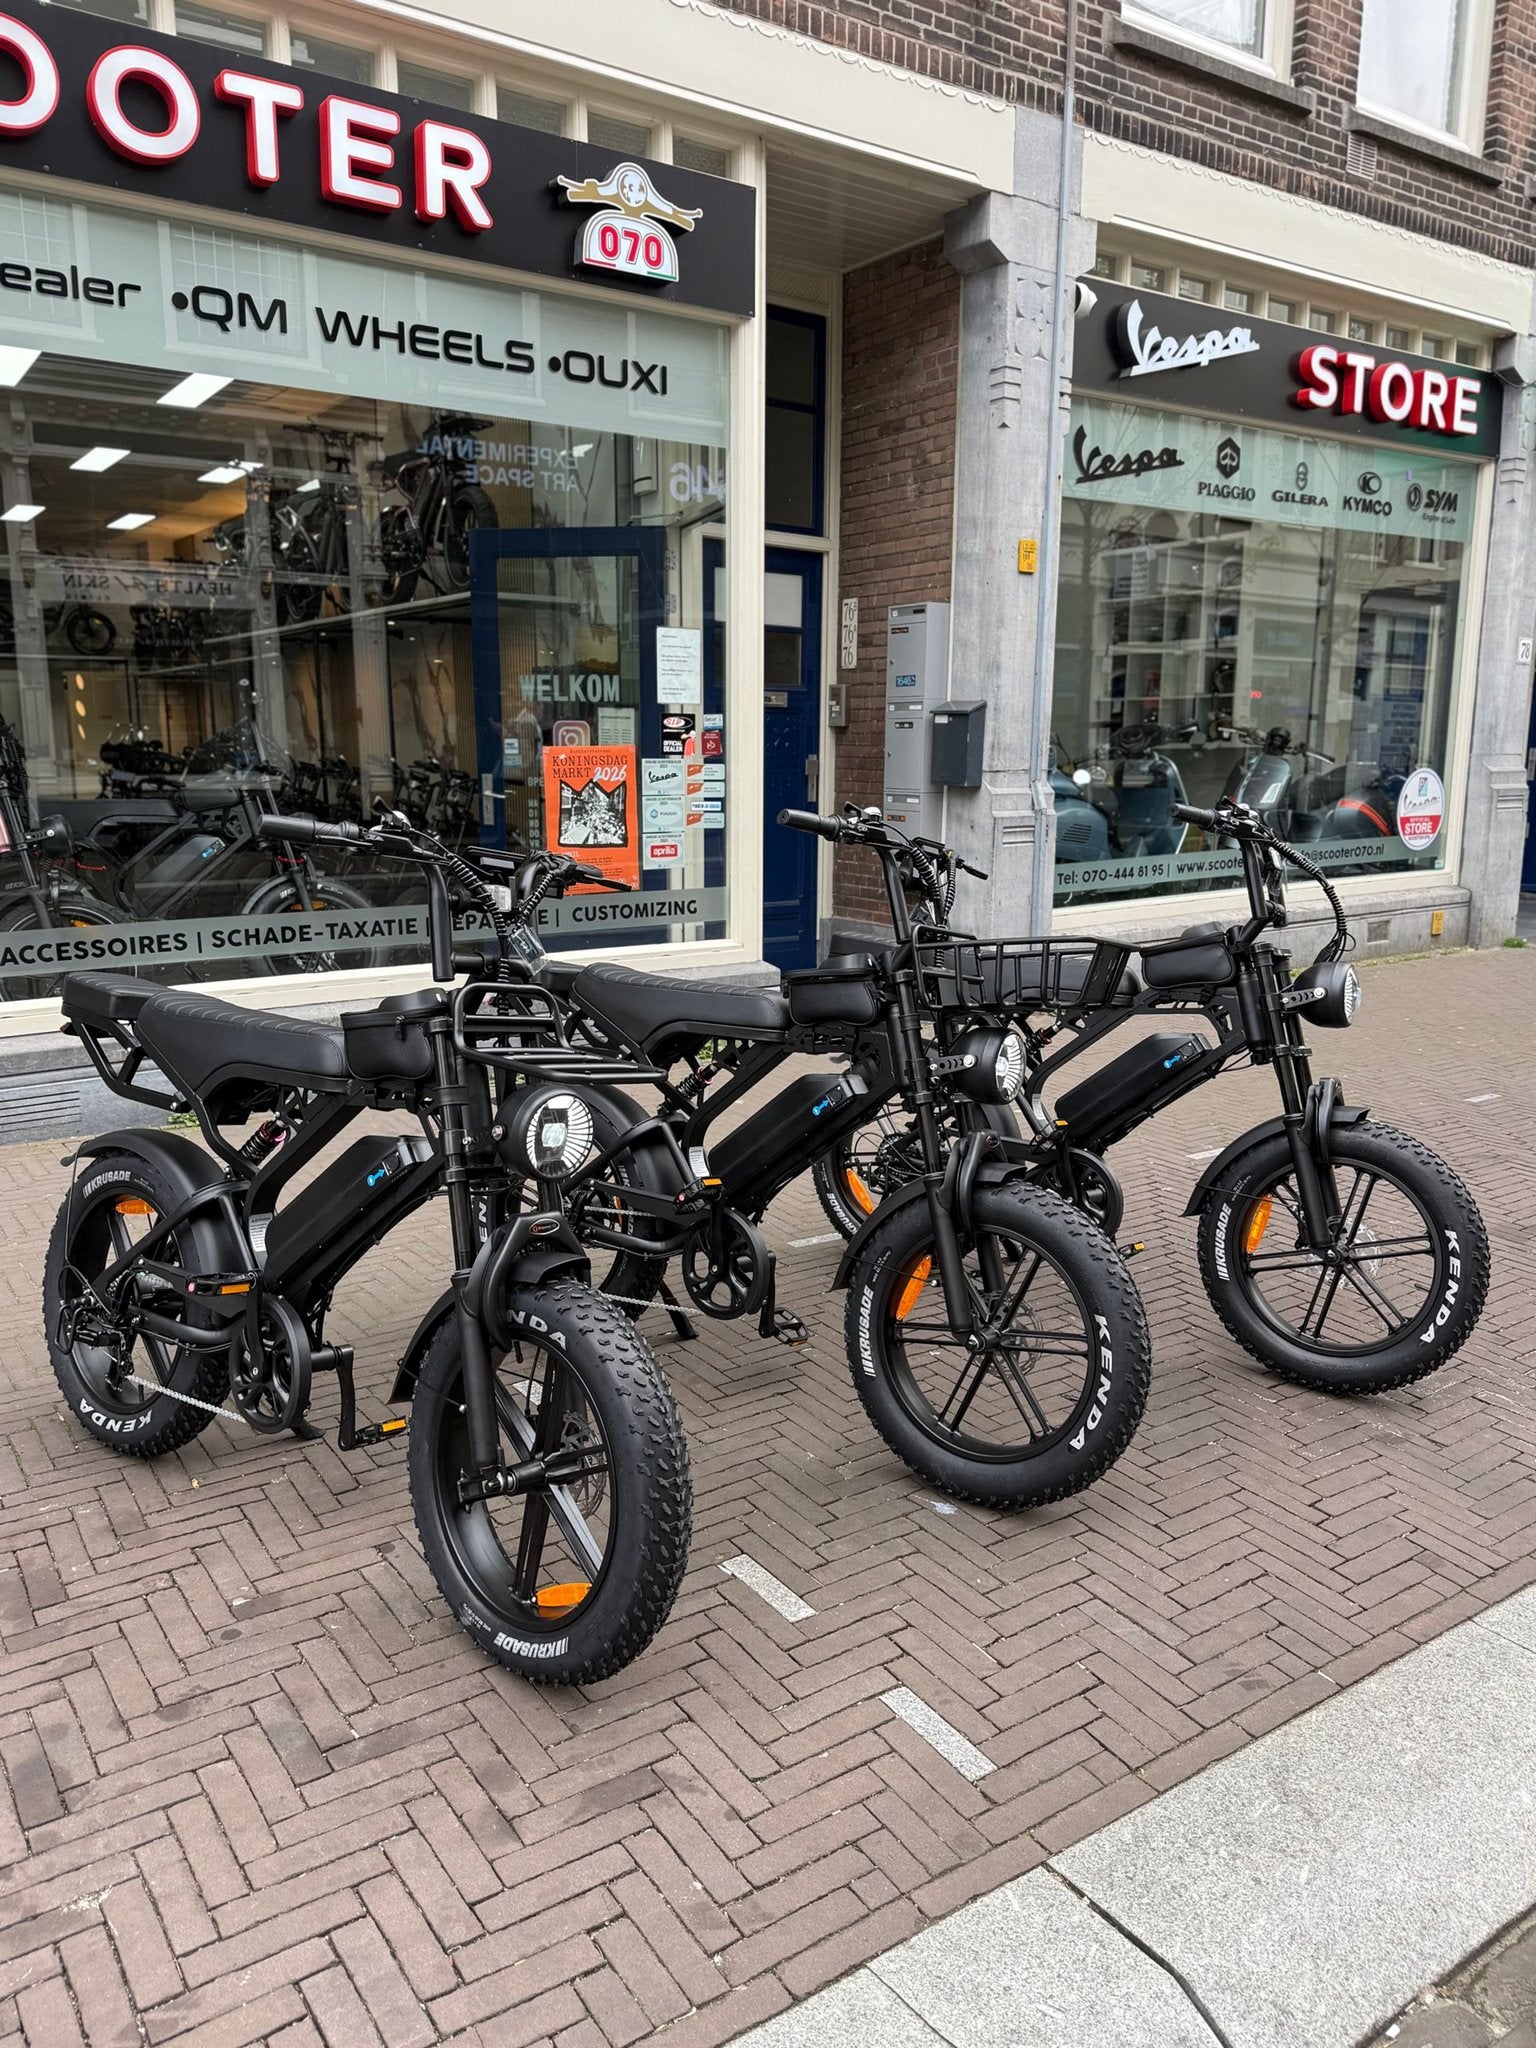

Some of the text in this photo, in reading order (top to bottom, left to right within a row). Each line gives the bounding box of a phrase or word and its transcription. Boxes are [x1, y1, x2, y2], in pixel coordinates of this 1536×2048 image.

[599, 223, 664, 270] 070
[0, 262, 142, 308] ealer
[315, 306, 536, 374] WHEELS
[1122, 298, 1483, 436] Vespa STORE
[1073, 423, 1185, 484] Vespa
[1197, 480, 1256, 502] PIAGGIO
[1271, 489, 1329, 508] GILERA
[1424, 489, 1458, 512] SYM
[1342, 495, 1393, 517] KYMCO
[843, 624, 854, 643] 76
[843, 646, 854, 666] 76
[519, 673, 620, 702] WELKOM
[552, 754, 628, 767] KONINGSDAG
[552, 767, 592, 783] MARKT
[592, 764, 628, 783] 2026
[648, 771, 679, 784] Vespa
[1404, 822, 1434, 835] STORE
[1057, 872, 1079, 886] Tel:
[1082, 865, 1135, 884] 070-444
[1137, 865, 1149, 878] 81
[1151, 863, 1164, 877] 95
[1176, 857, 1244, 875] www.scoote
[572, 899, 698, 922] CUSTOMIZING
[2, 930, 188, 966] ACCESSOIRES
[211, 917, 418, 949] SCHADE-TAXATIE
[90, 1170, 131, 1192] KRUSADE
[1214, 1202, 1233, 1268] KRUSADE
[1419, 1229, 1461, 1344] KENDA
[506, 1309, 567, 1351] NDA
[858, 1284, 875, 1360] KRUSADE
[1069, 1313, 1113, 1450] KENDA
[80, 1398, 153, 1433] KENDA
[493, 1631, 558, 1659] KRUSADE
